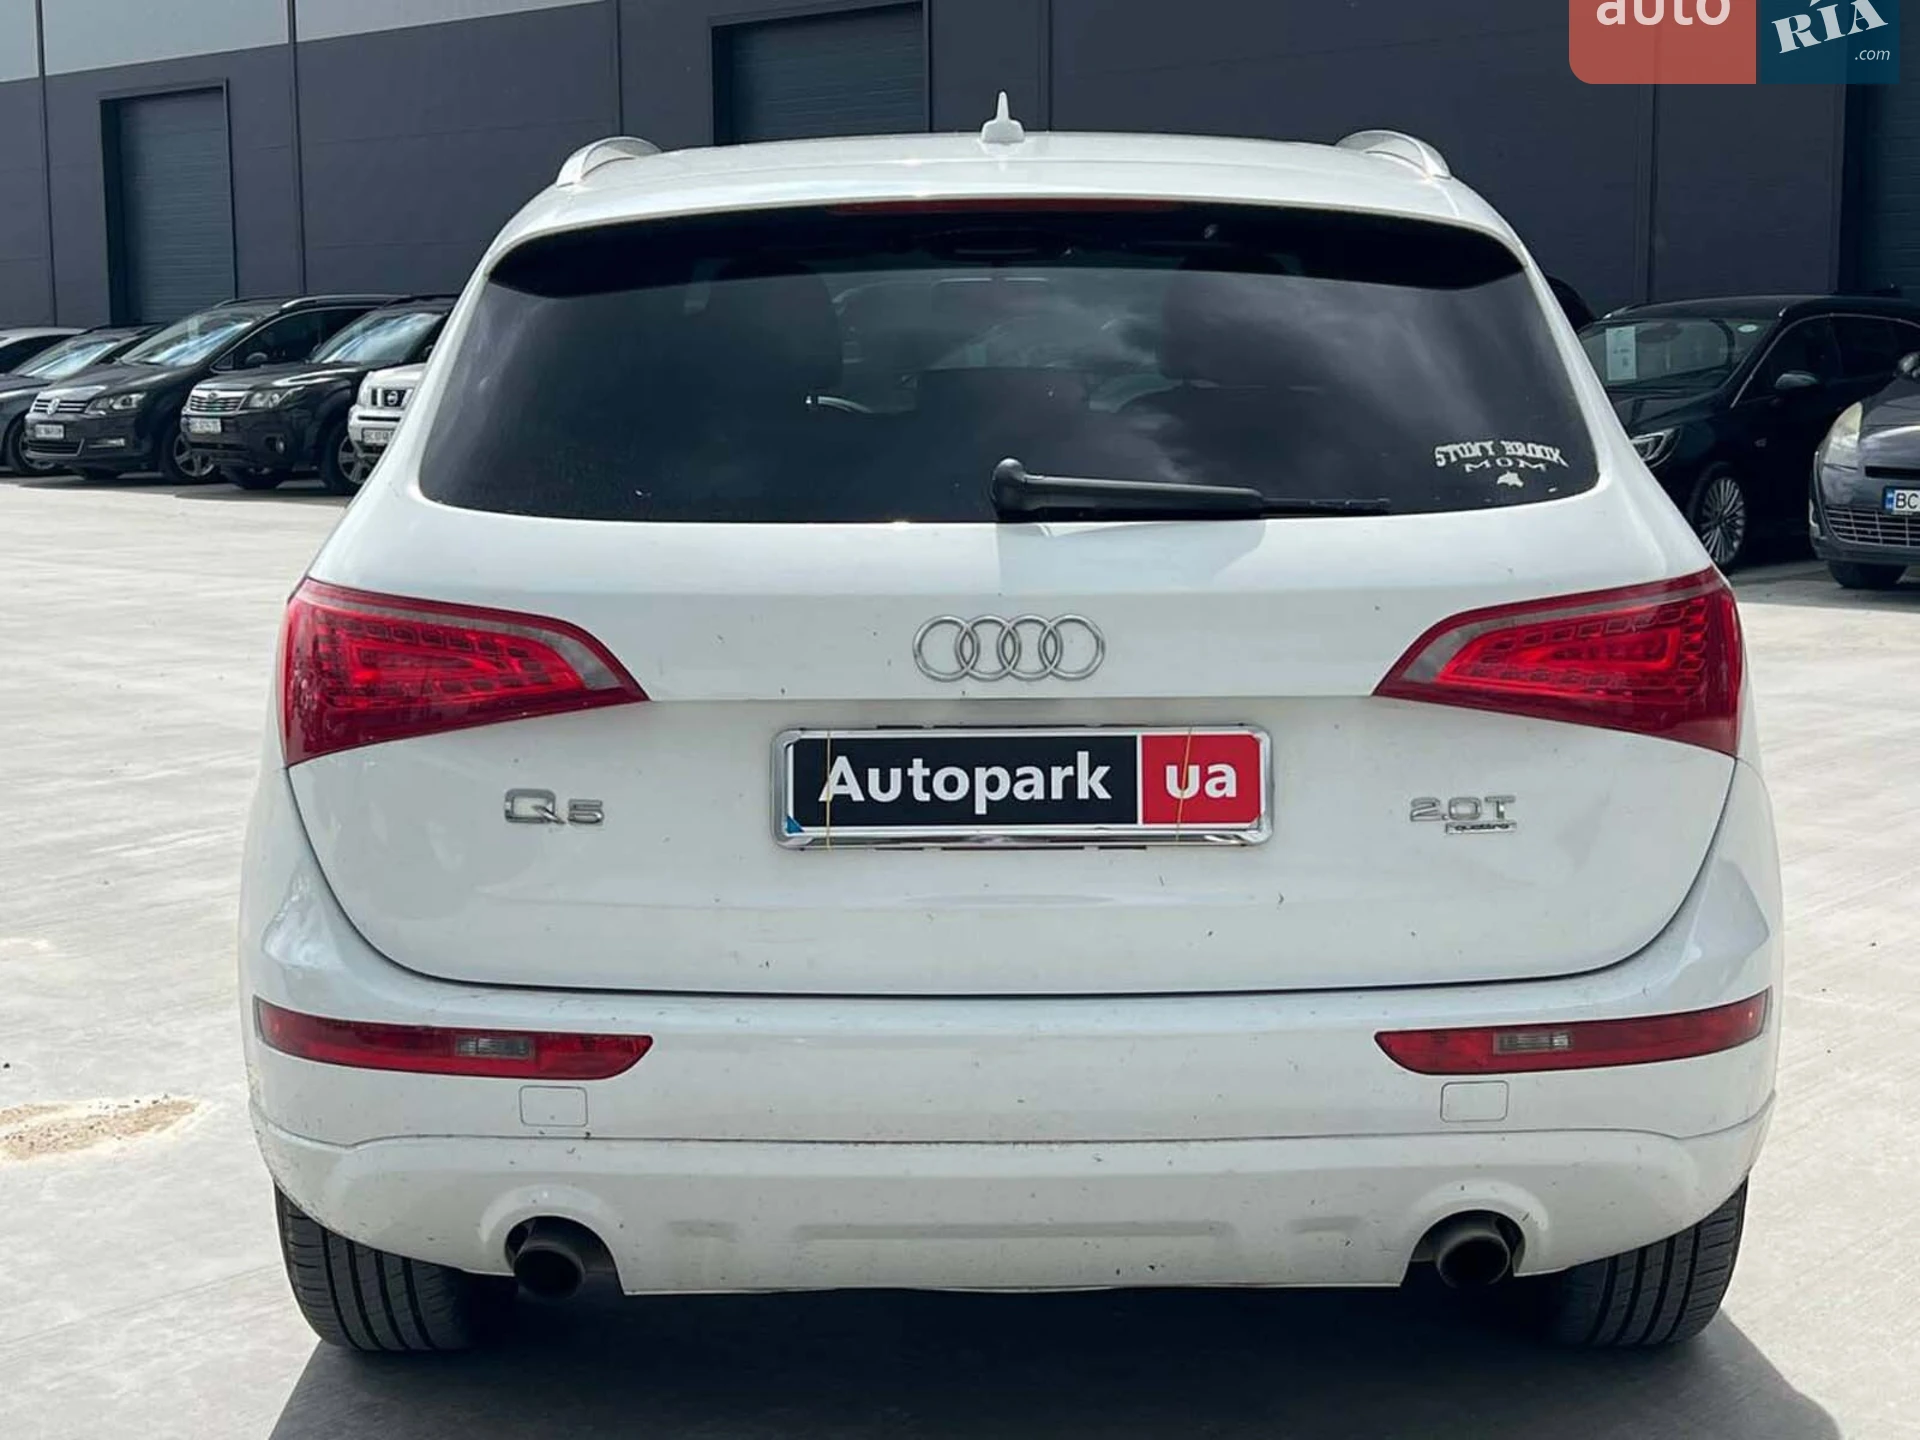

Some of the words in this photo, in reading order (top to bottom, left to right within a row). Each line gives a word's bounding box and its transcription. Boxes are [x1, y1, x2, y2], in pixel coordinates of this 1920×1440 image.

[1463, 457, 1547, 473] MOM
[818, 750, 1113, 815] Autopark
[1165, 762, 1238, 798] ua
[505, 788, 605, 825] Q5
[1410, 795, 1517, 822] 2.0T
